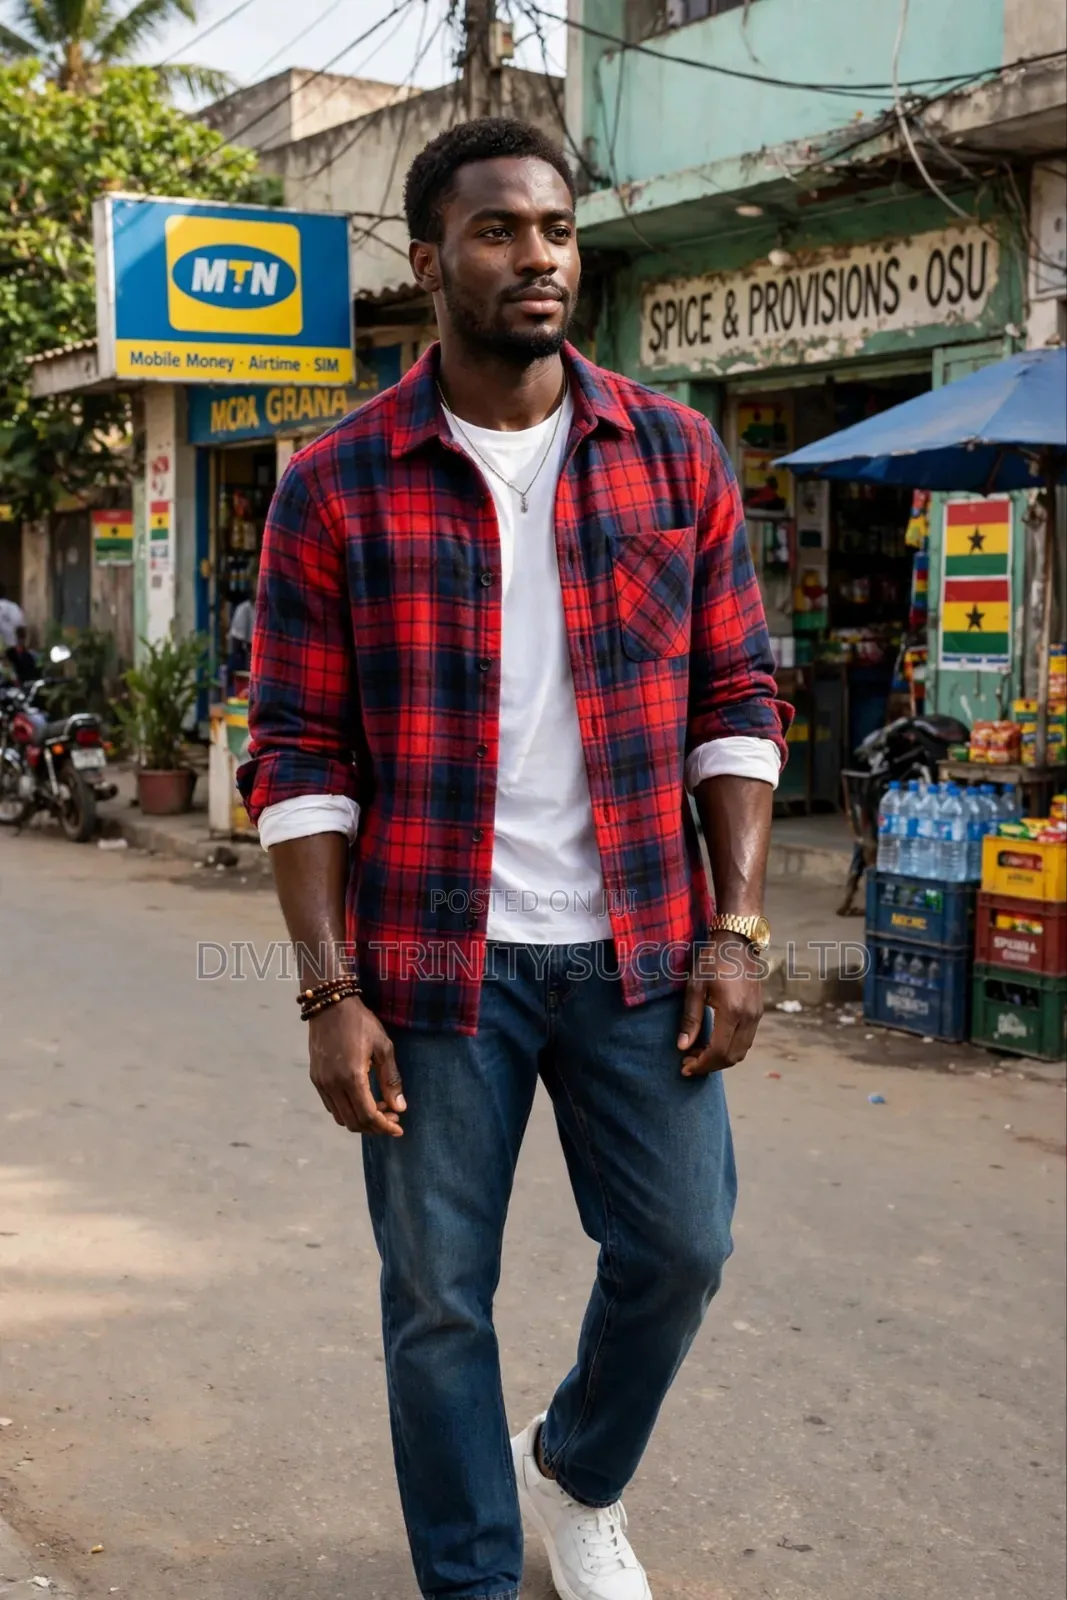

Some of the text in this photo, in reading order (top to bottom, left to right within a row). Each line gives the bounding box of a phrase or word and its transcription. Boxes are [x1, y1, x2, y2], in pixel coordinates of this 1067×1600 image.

[191, 257, 279, 296] MTN
[648, 241, 989, 353] SPICE & PROVISIONS OSU
[130, 351, 340, 373] Mobile Money Airtime SIM
